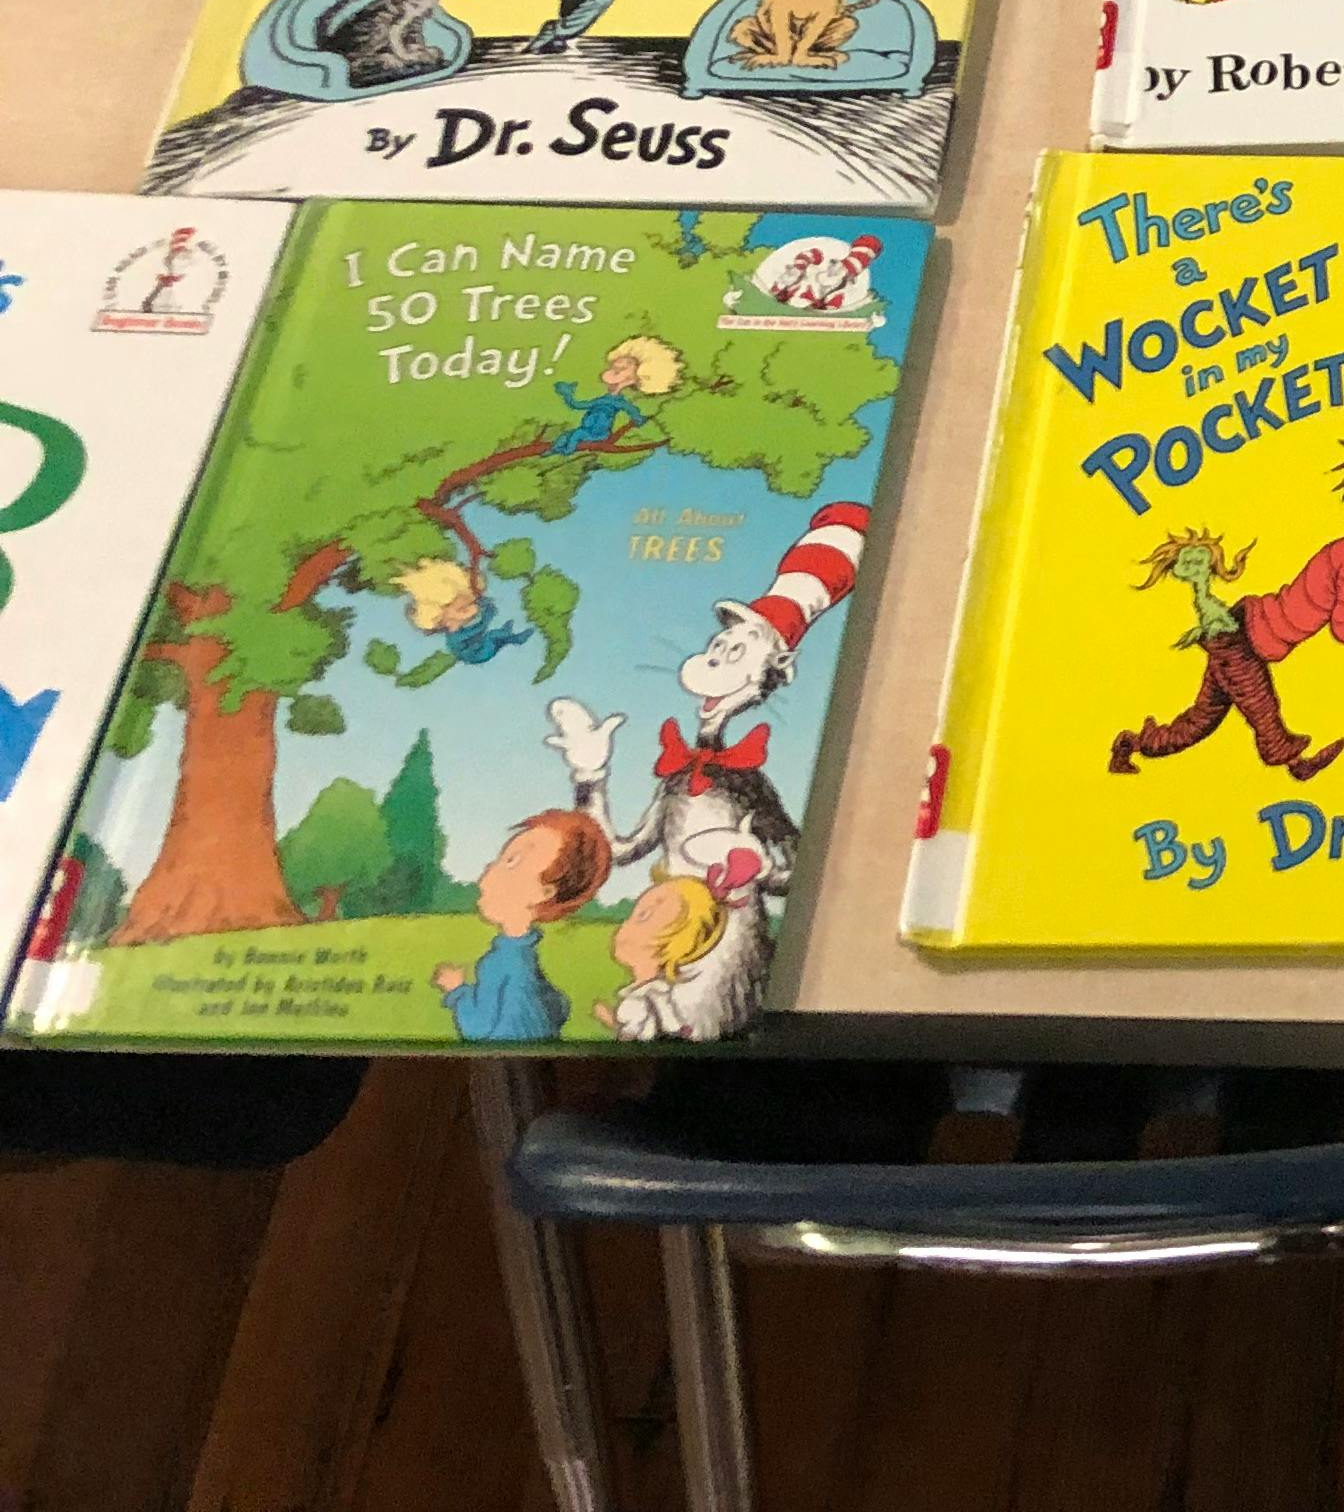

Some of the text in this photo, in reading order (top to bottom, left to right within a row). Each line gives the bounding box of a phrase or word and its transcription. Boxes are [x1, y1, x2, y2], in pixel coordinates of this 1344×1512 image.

[1077, 176, 1295, 267] There's
[345, 234, 638, 289] I Can Name
[1171, 253, 1208, 288] a
[365, 285, 597, 334] 50 Trees
[1042, 243, 1340, 404] WOCKET
[377, 333, 572, 388] Today!
[1180, 332, 1290, 400] in my
[628, 535, 724, 563] TREES
